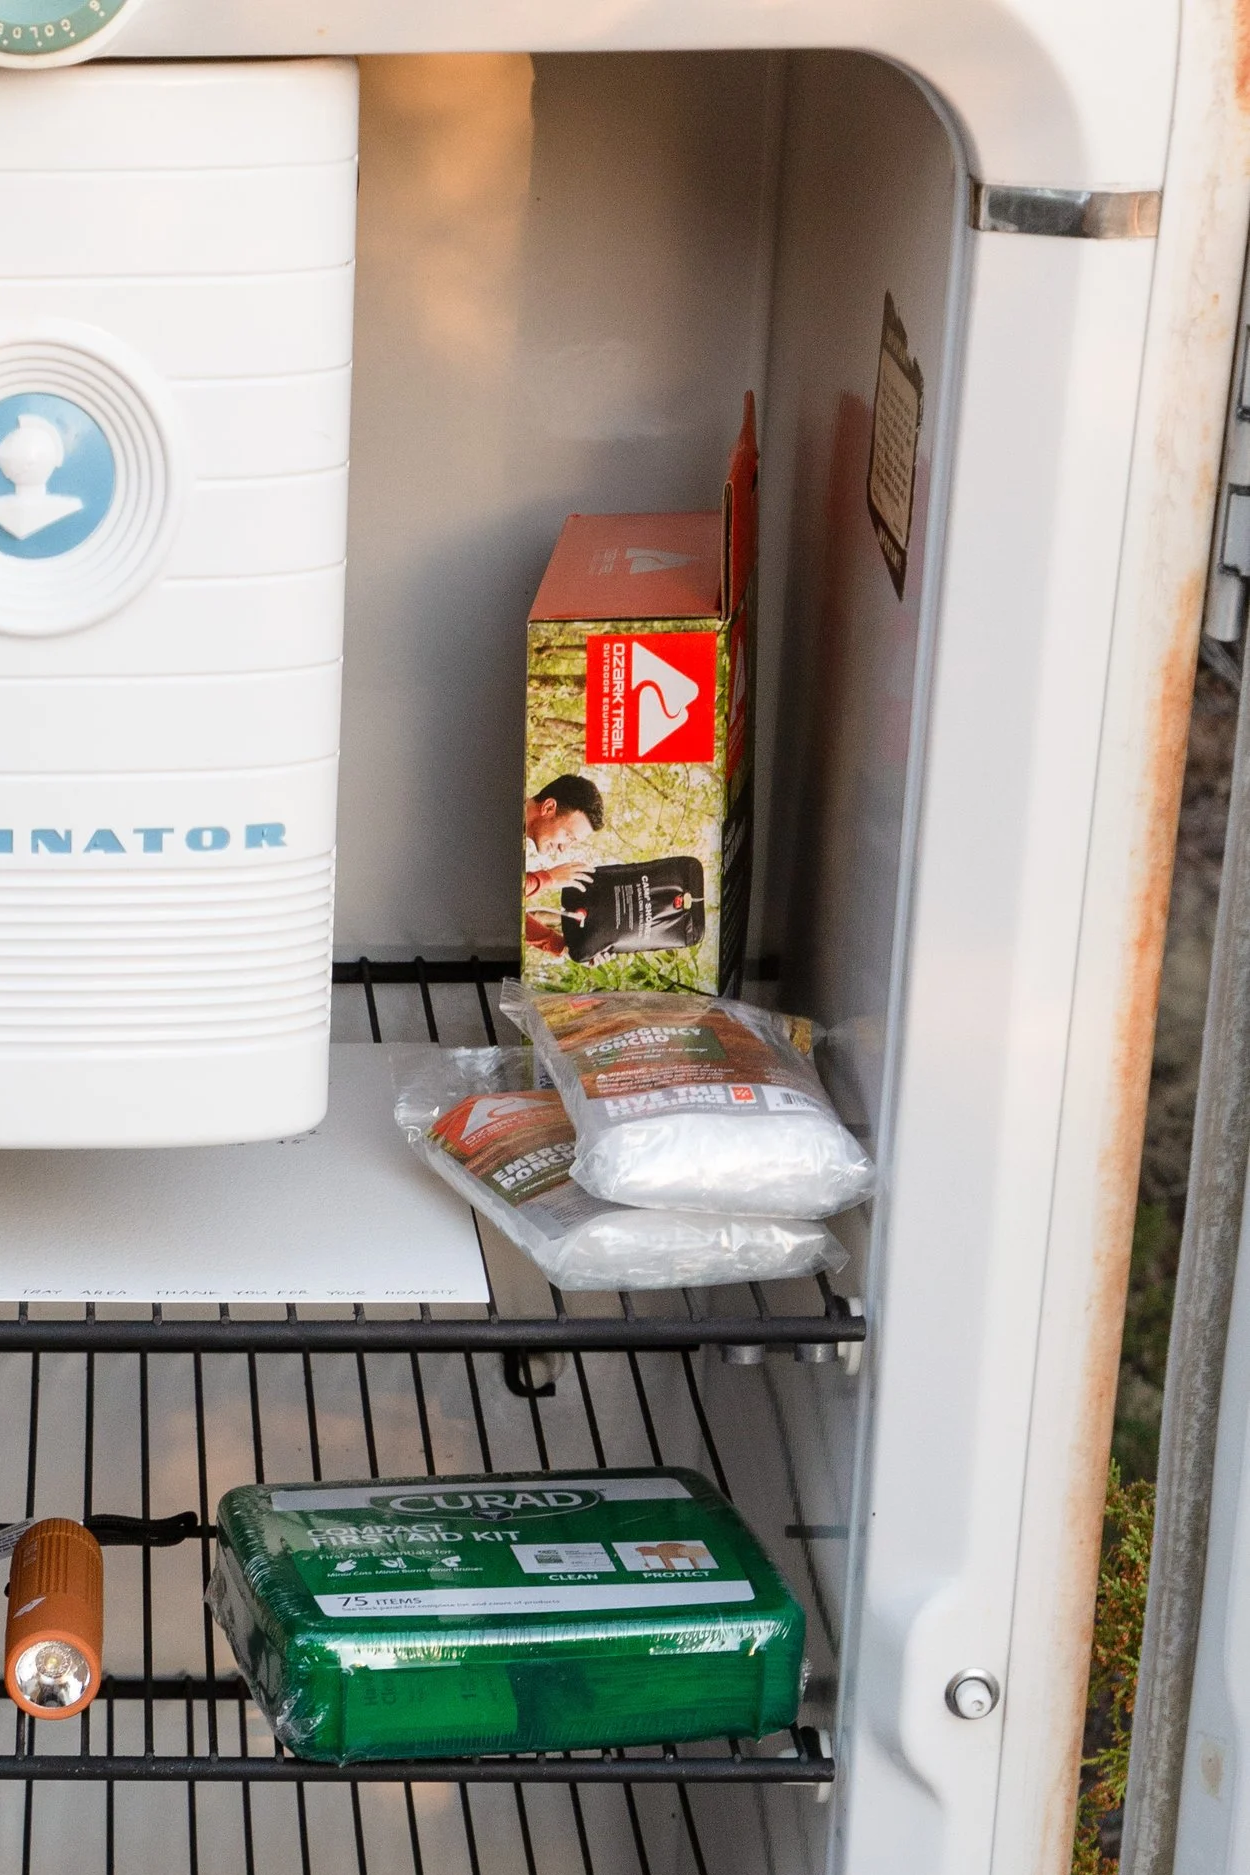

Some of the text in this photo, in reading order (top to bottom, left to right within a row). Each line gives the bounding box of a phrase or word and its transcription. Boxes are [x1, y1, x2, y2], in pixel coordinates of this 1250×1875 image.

[611, 643, 626, 757] OZARK TRAIL
[602, 698, 610, 757] EQUIPMENT
[389, 1491, 583, 1512] CURAD
[307, 1524, 443, 1538] COMPACT
[312, 1530, 520, 1548] FIRST AID KIT
[548, 1573, 598, 1581] CLEAN
[642, 1571, 710, 1579] PROTECT
[337, 1595, 369, 1607] 75
[375, 1597, 423, 1605] ITEMS
